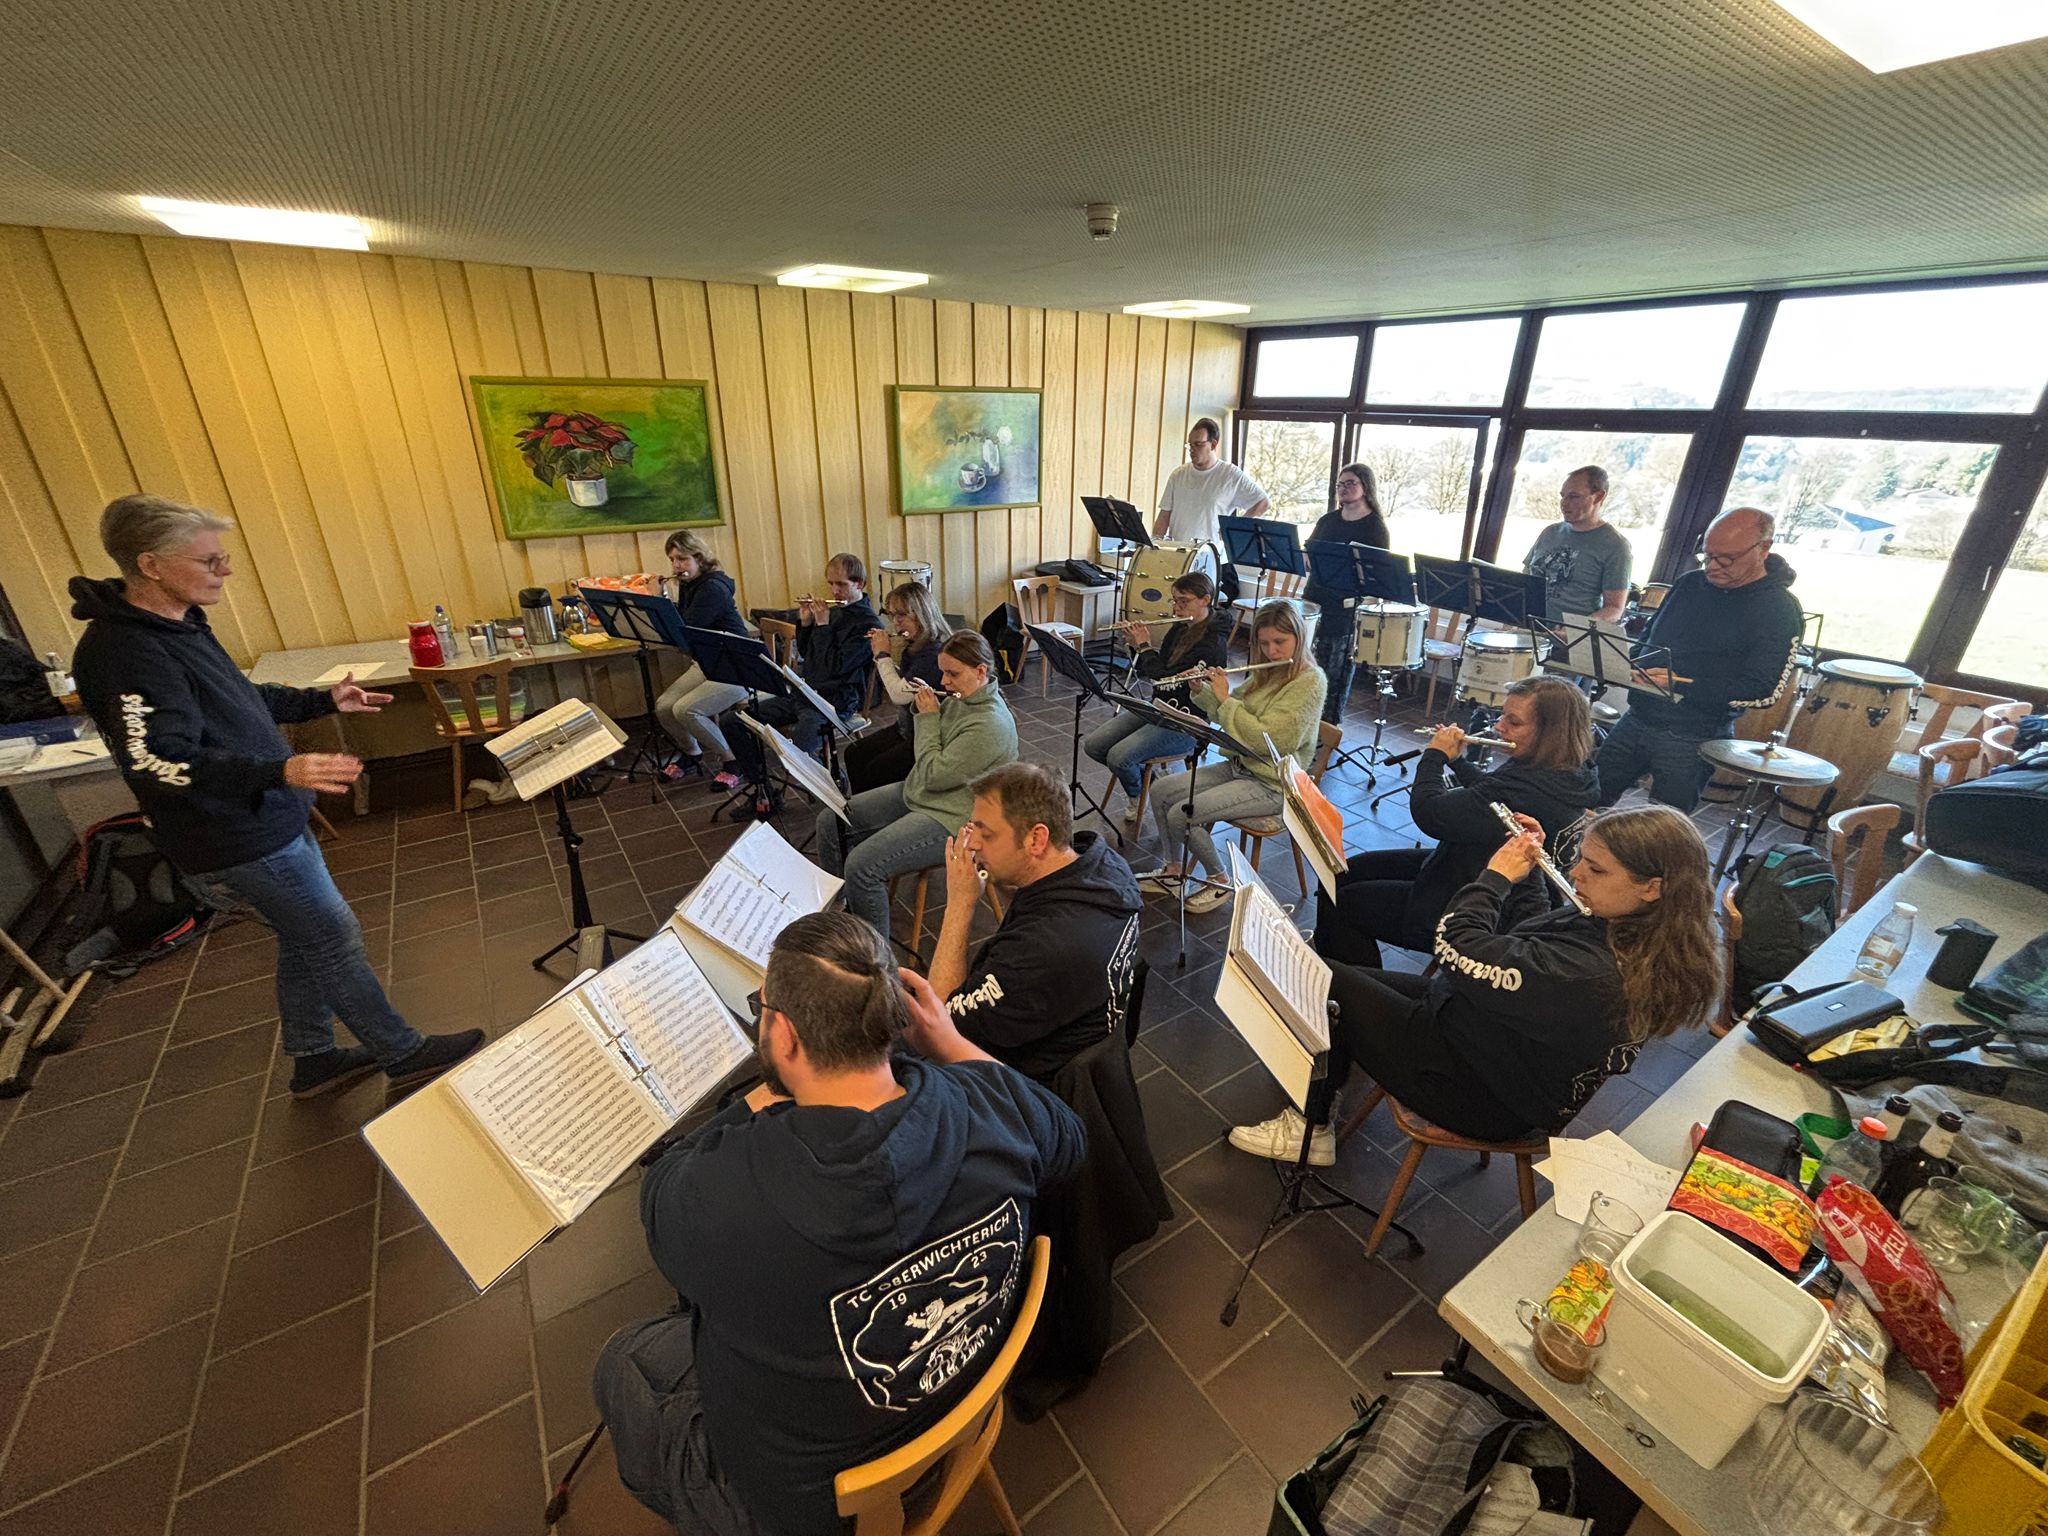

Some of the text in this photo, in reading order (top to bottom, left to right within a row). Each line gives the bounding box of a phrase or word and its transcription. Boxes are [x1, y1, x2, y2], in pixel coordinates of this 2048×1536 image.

[847, 1211, 1010, 1309] TC OBERWICHTERICH
[888, 1250, 988, 1311] 19 23
